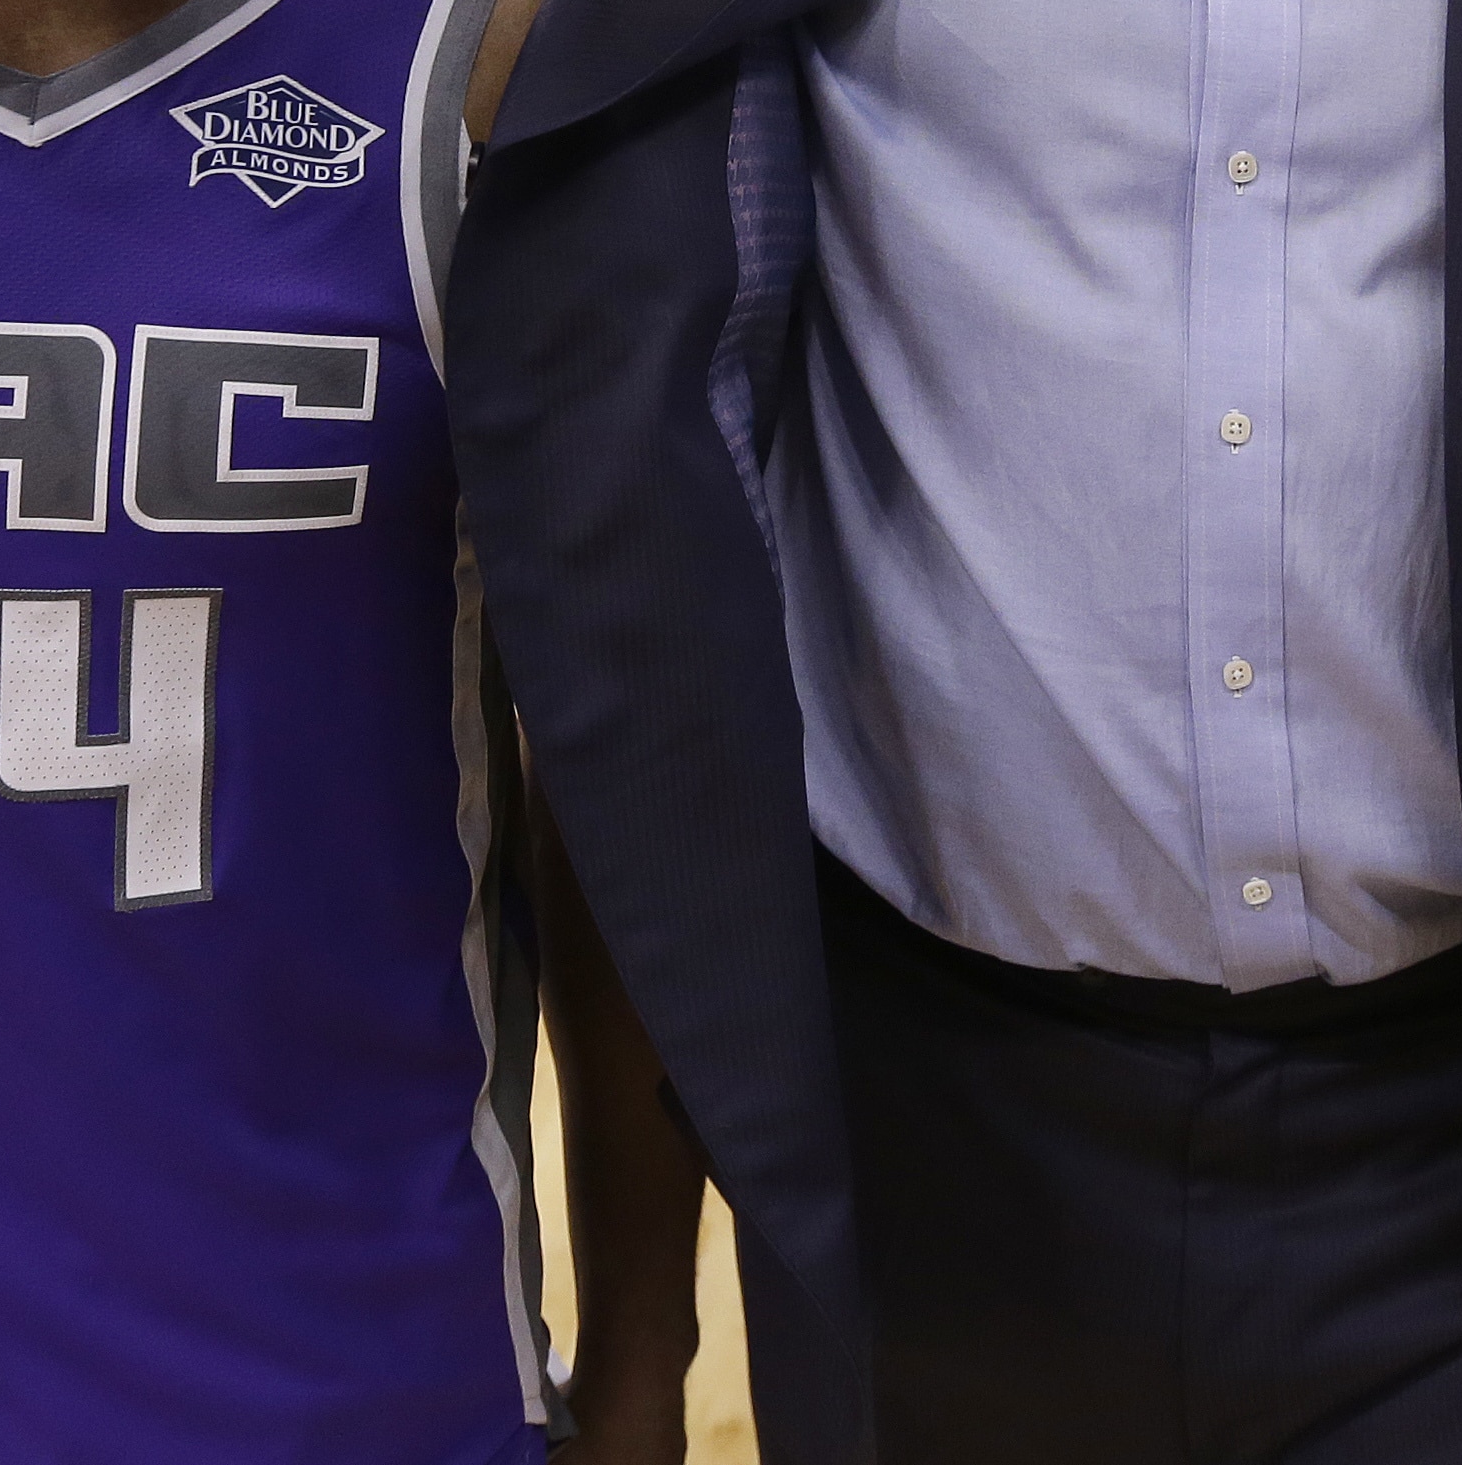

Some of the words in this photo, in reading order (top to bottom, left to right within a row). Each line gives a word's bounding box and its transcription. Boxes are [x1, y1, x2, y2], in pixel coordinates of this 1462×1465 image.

[246, 90, 319, 126] BLUE
[203, 111, 357, 152] DIAMOND
[210, 149, 349, 181] ALMONDS
